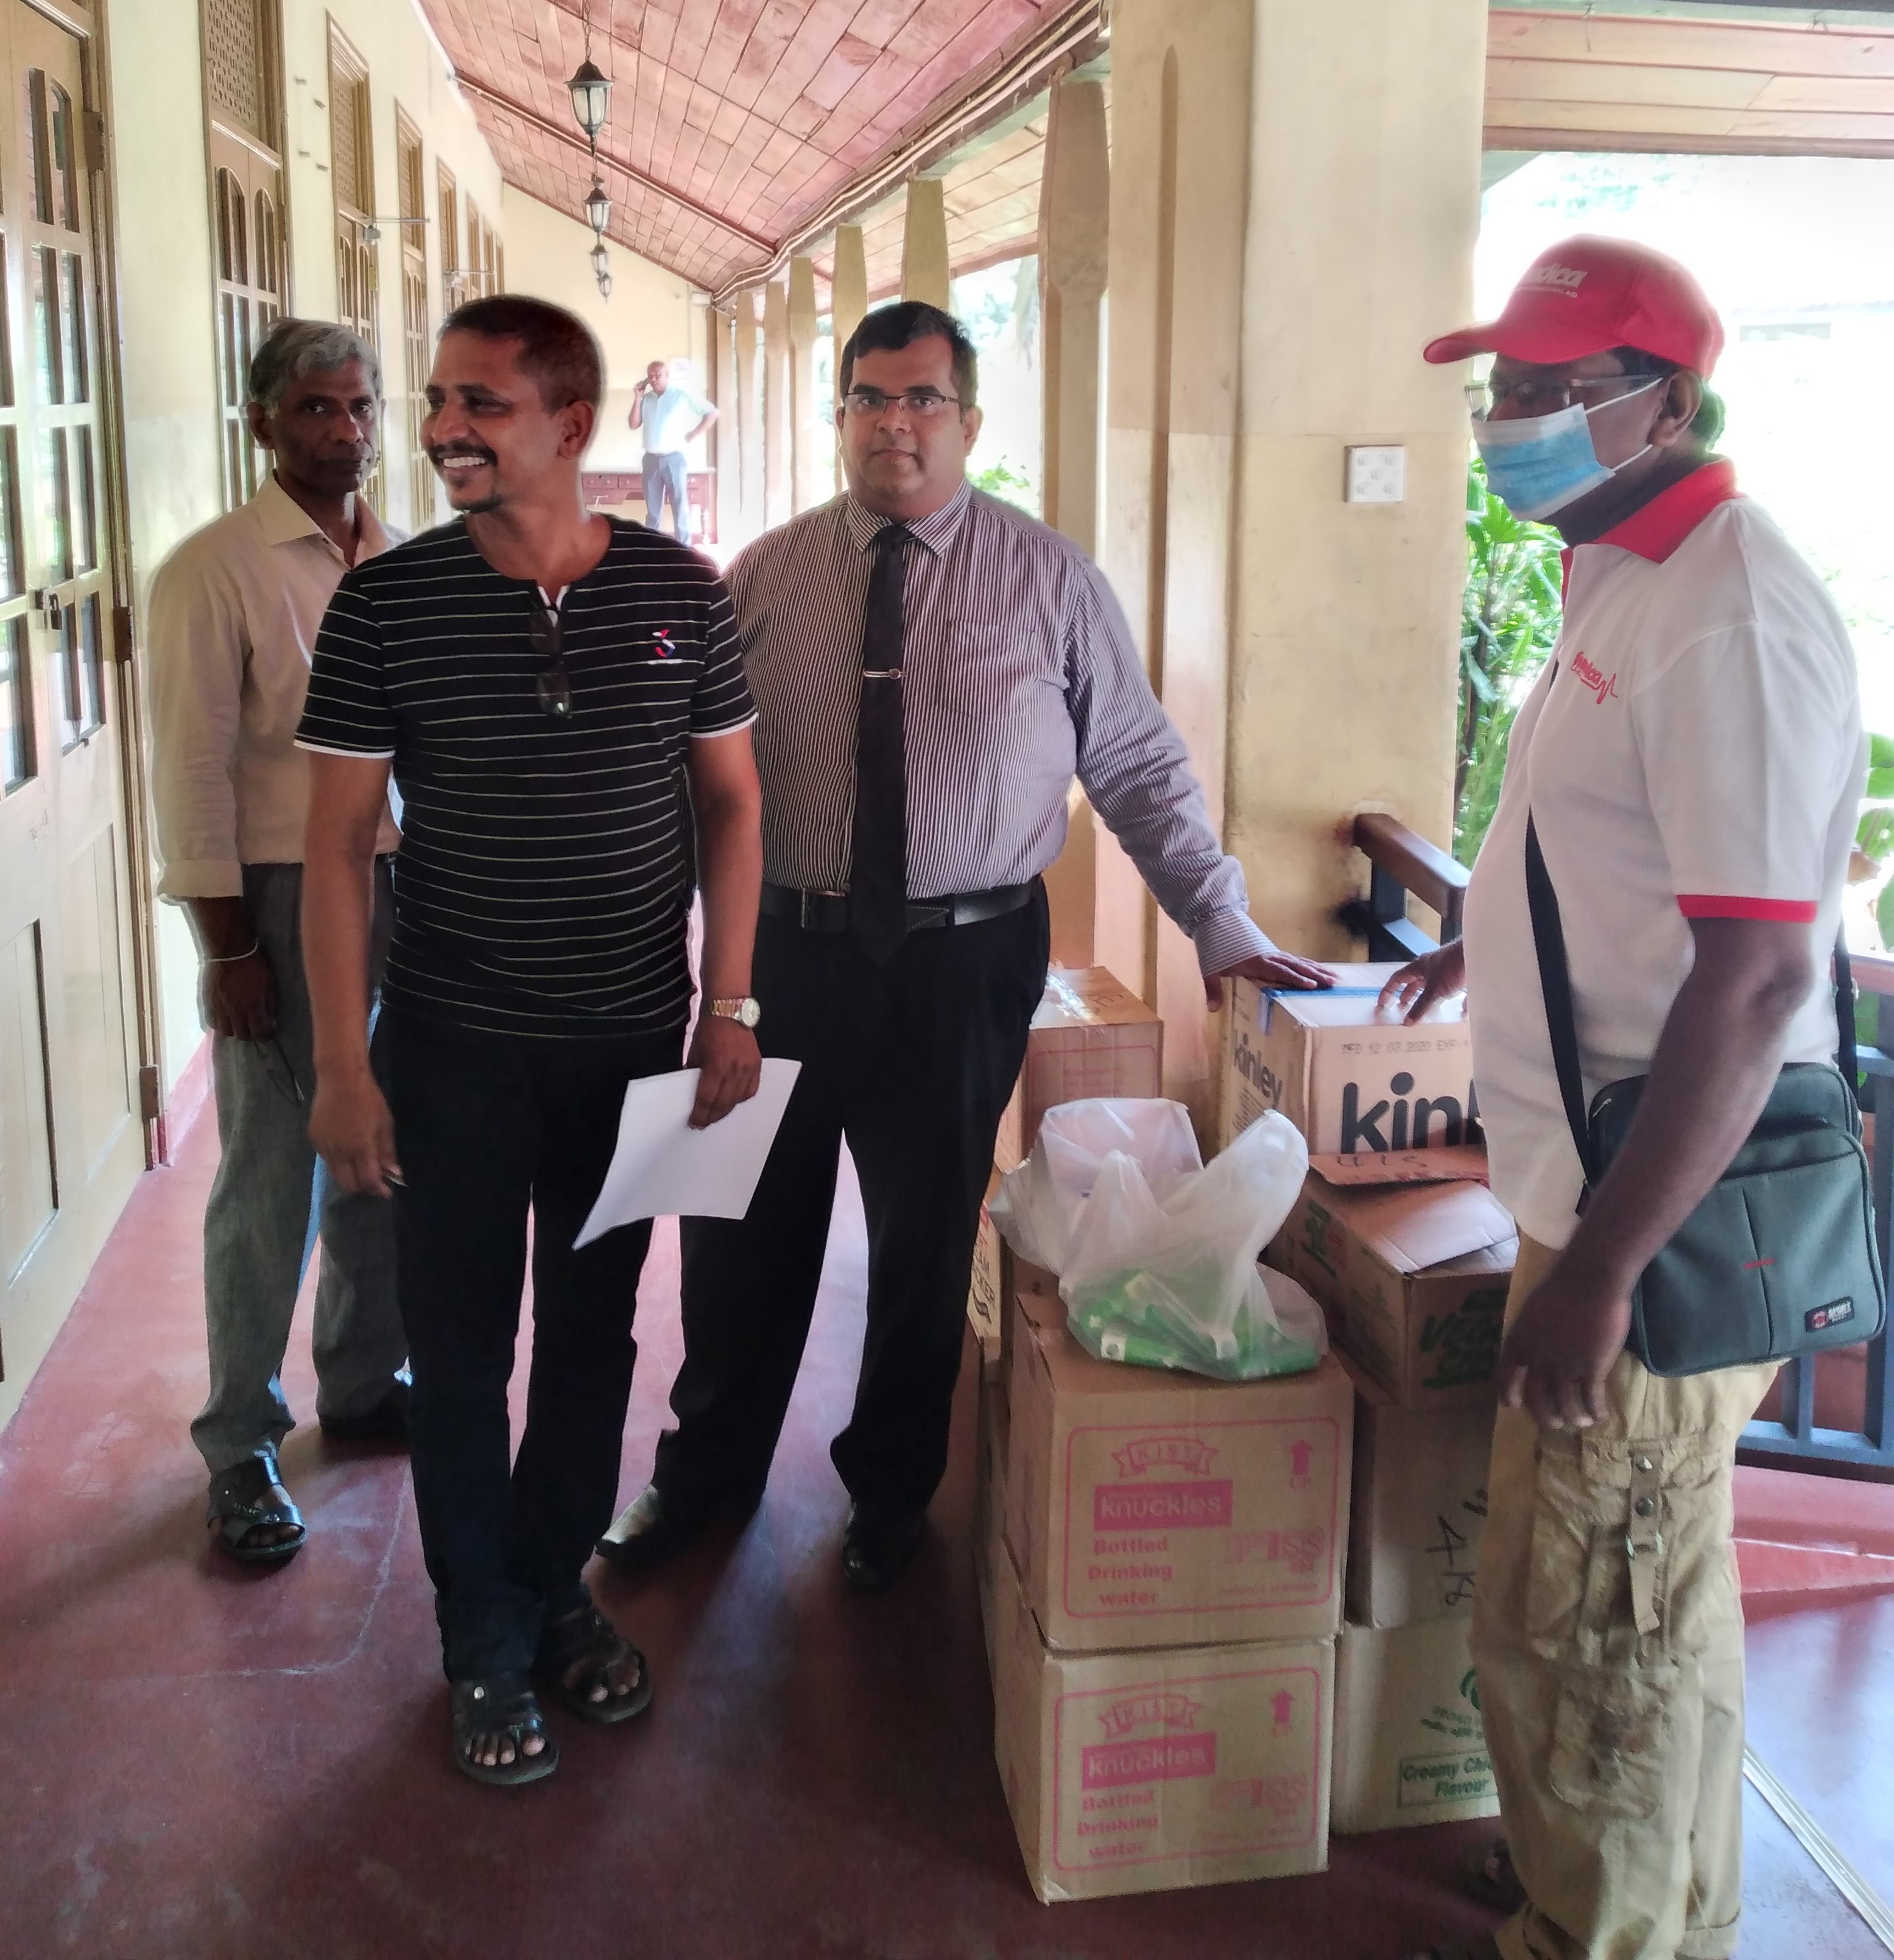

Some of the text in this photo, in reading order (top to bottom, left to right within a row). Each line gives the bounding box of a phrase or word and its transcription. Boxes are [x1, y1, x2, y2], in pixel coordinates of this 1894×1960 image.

[1100, 1492, 1223, 1520] knuckles
[1094, 1536, 1169, 1556] Bottled
[1087, 1564, 1174, 1582] Drinking
[1099, 1591, 1158, 1606] water
[1088, 1746, 1206, 1779] knuckles
[1082, 1789, 1155, 1813] Bottled
[1077, 1814, 1159, 1837] Drinking
